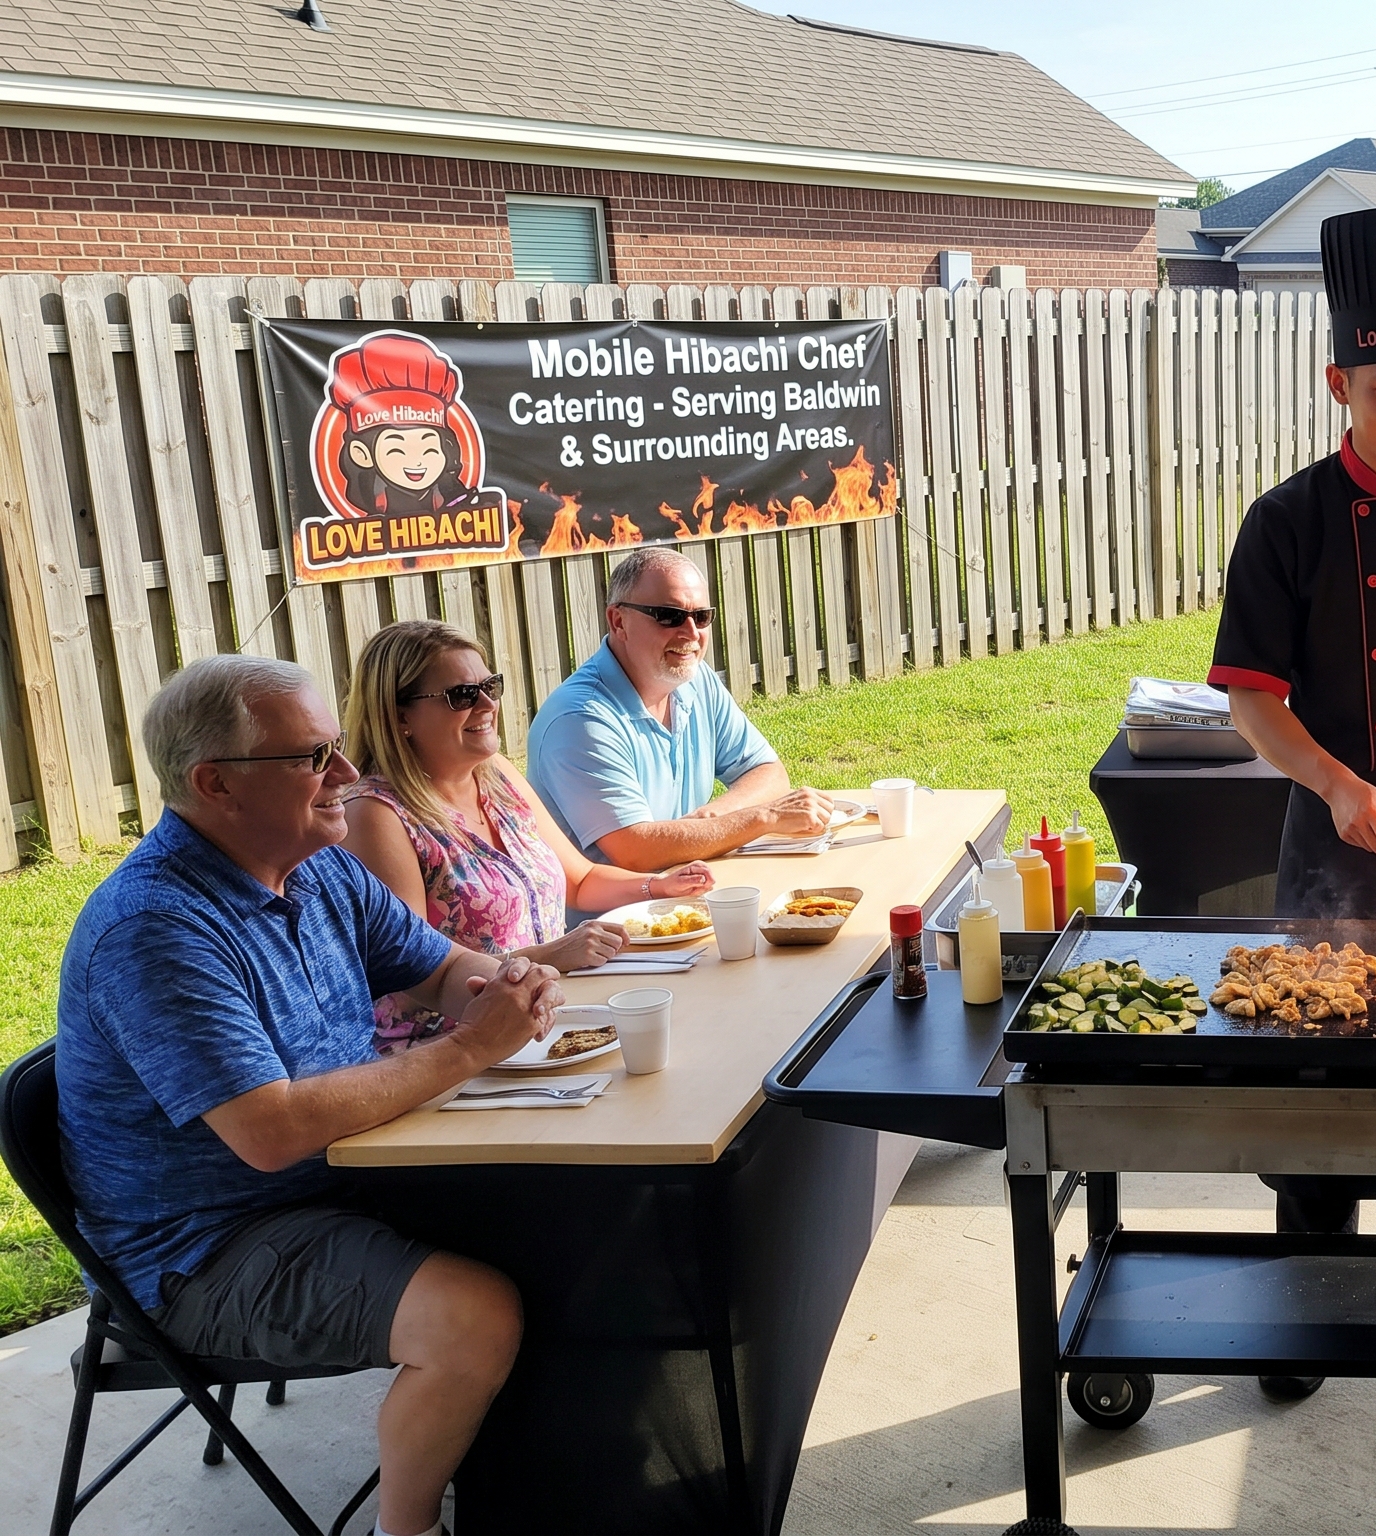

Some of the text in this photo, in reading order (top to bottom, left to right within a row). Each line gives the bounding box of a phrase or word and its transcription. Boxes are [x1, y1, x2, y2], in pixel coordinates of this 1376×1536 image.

[527, 334, 867, 378] Mobile Hibachi Chef
[356, 410, 390, 427] Love
[508, 390, 645, 428] Catering
[671, 384, 777, 420] Serving
[783, 379, 881, 411] Baldwin
[560, 423, 854, 467] & Surrounding Areas.
[309, 507, 501, 560] LOVE HIBACHI
